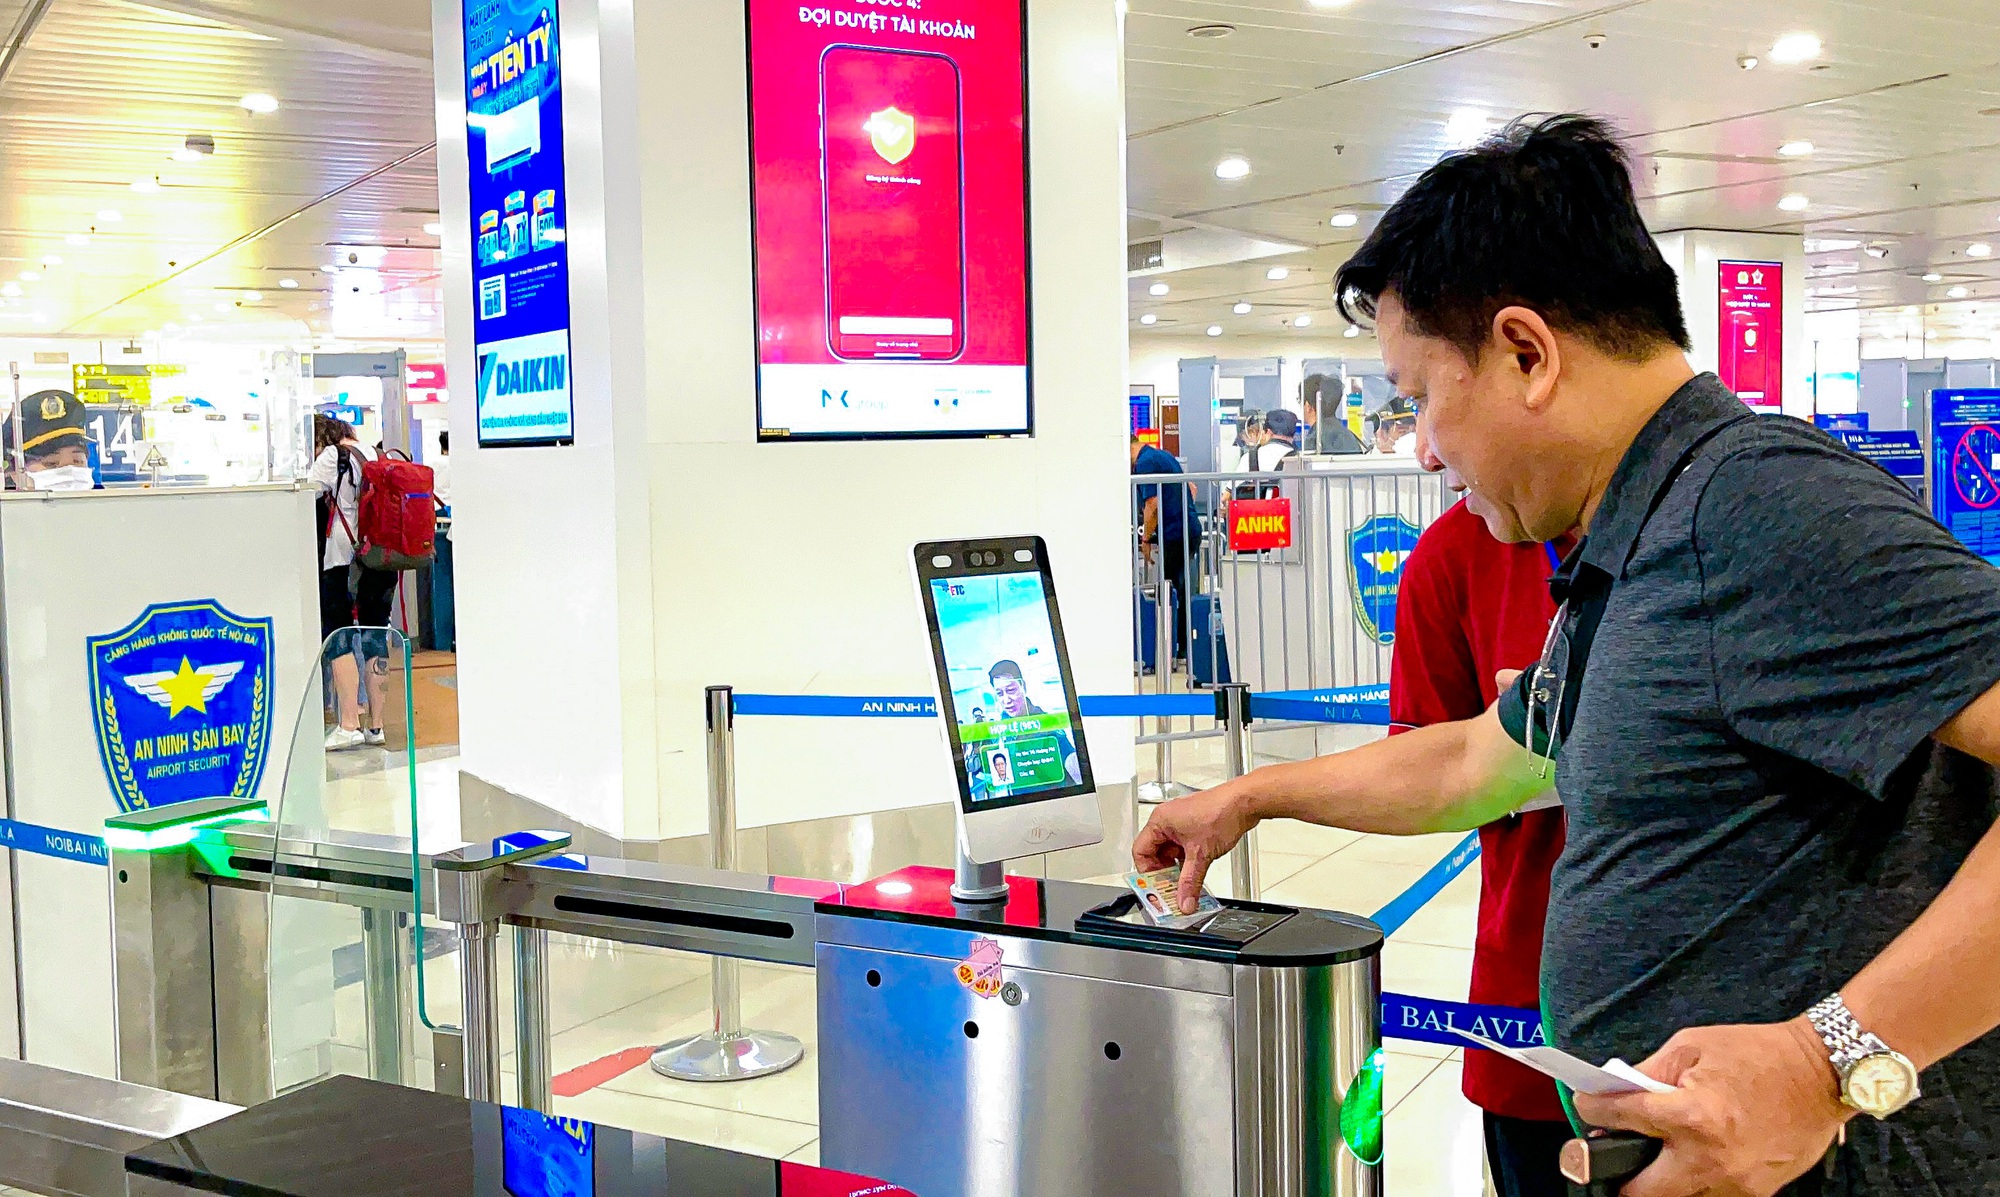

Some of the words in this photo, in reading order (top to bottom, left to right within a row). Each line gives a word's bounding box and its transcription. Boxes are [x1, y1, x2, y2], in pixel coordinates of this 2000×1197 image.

[527, 8, 551, 69] TỶ
[799, 6, 830, 28] ĐỢI
[834, 11, 887, 34] DUYỆT
[890, 14, 915, 34] TÀI
[919, 19, 975, 40] KHOẢN
[496, 354, 565, 397] DAIKIN
[89, 414, 134, 464] 14
[1236, 515, 1285, 534] ANHK
[105, 643, 130, 664] CẢNG
[130, 635, 156, 652] HÀNG
[157, 628, 189, 644] KHÔNG
[190, 624, 215, 640] QUỐC
[217, 625, 229, 640] TẾ
[861, 702, 883, 712] AN
[886, 702, 921, 712] NINH
[925, 702, 937, 713] H
[134, 738, 154, 762] AN
[157, 732, 189, 757] NINH
[192, 723, 219, 752] SÂN
[222, 723, 246, 747] BAY
[146, 761, 186, 780] AIRPORT
[188, 753, 231, 773] SECURITY
